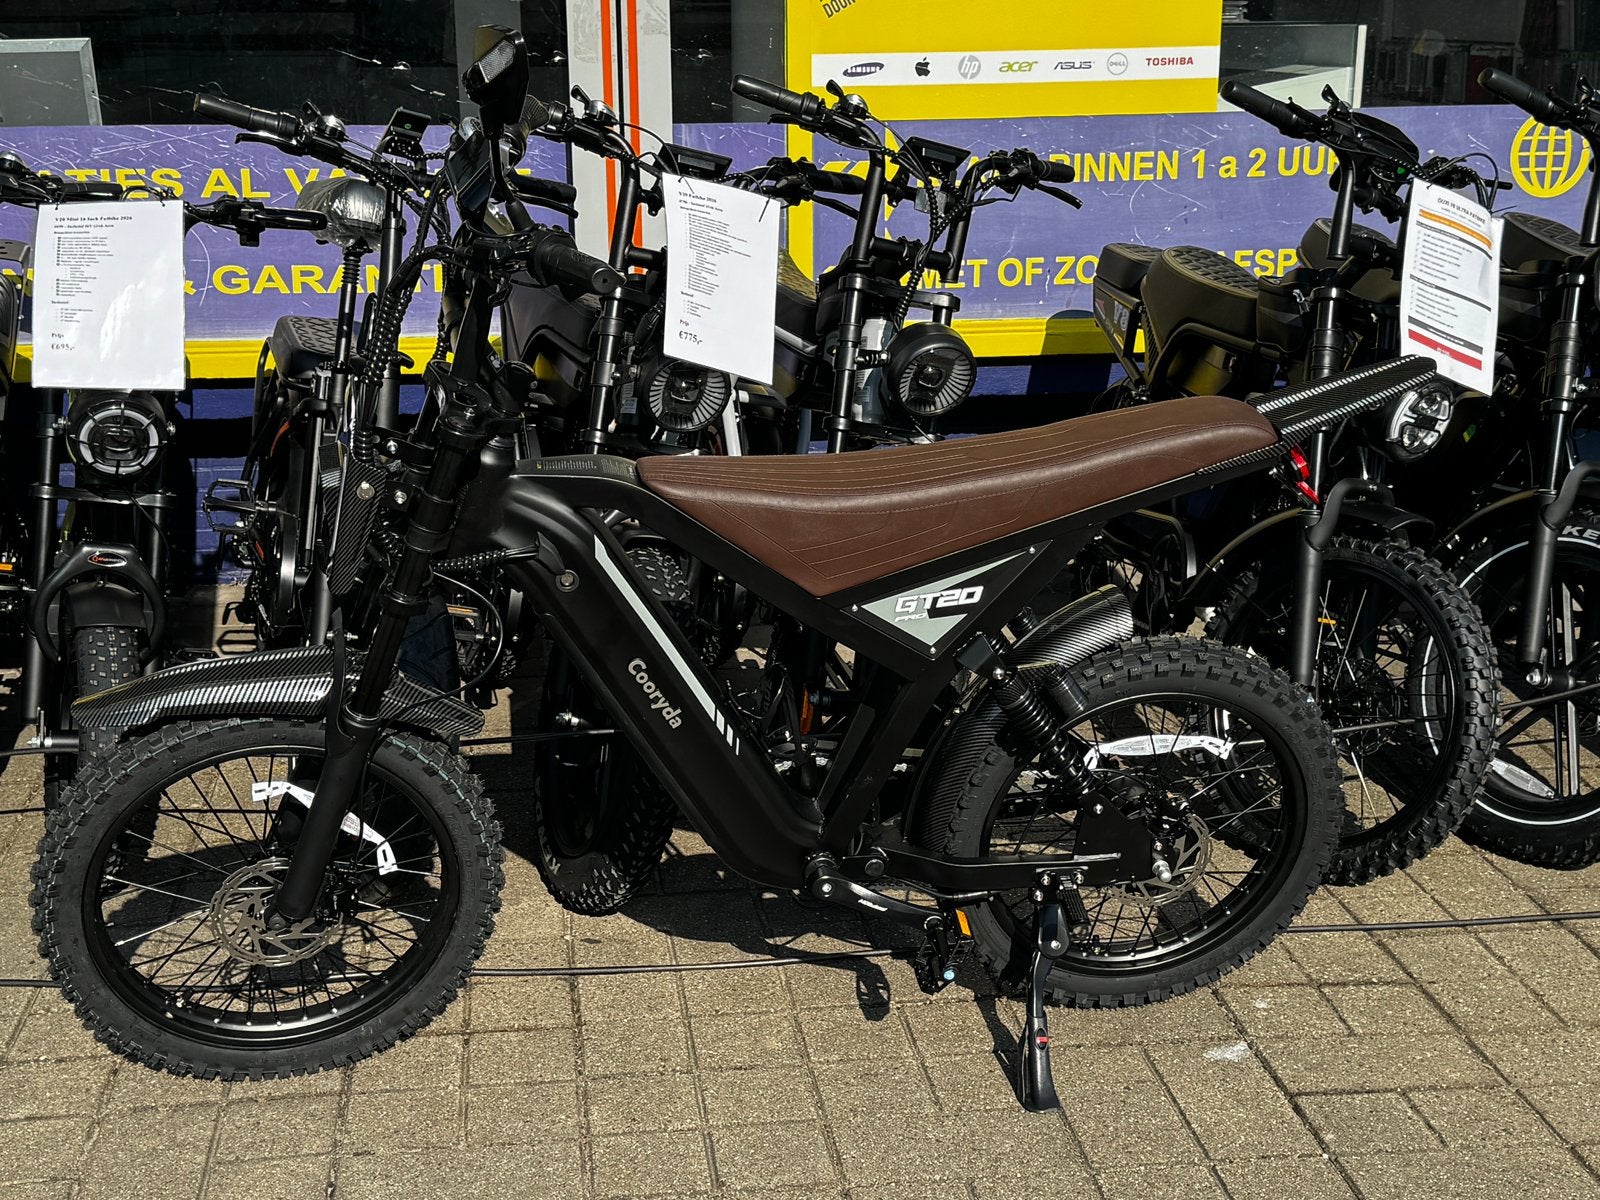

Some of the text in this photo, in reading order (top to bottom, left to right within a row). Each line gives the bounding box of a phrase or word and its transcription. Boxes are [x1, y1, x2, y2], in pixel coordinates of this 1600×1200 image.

[845, 64, 882, 75] SAMSUNG
[959, 55, 980, 79] hp
[999, 61, 1038, 73] acer
[1054, 61, 1093, 71] ASUS
[1145, 56, 1194, 67] TOSHIBA
[1191, 148, 1206, 179] 1
[1218, 156, 1237, 178] a
[1246, 147, 1267, 177] 2
[37, 168, 184, 198] TIES
[200, 168, 271, 198] AL
[997, 257, 1044, 287] OF
[895, 586, 984, 614] GT20
[628, 657, 682, 729] Cooryda
